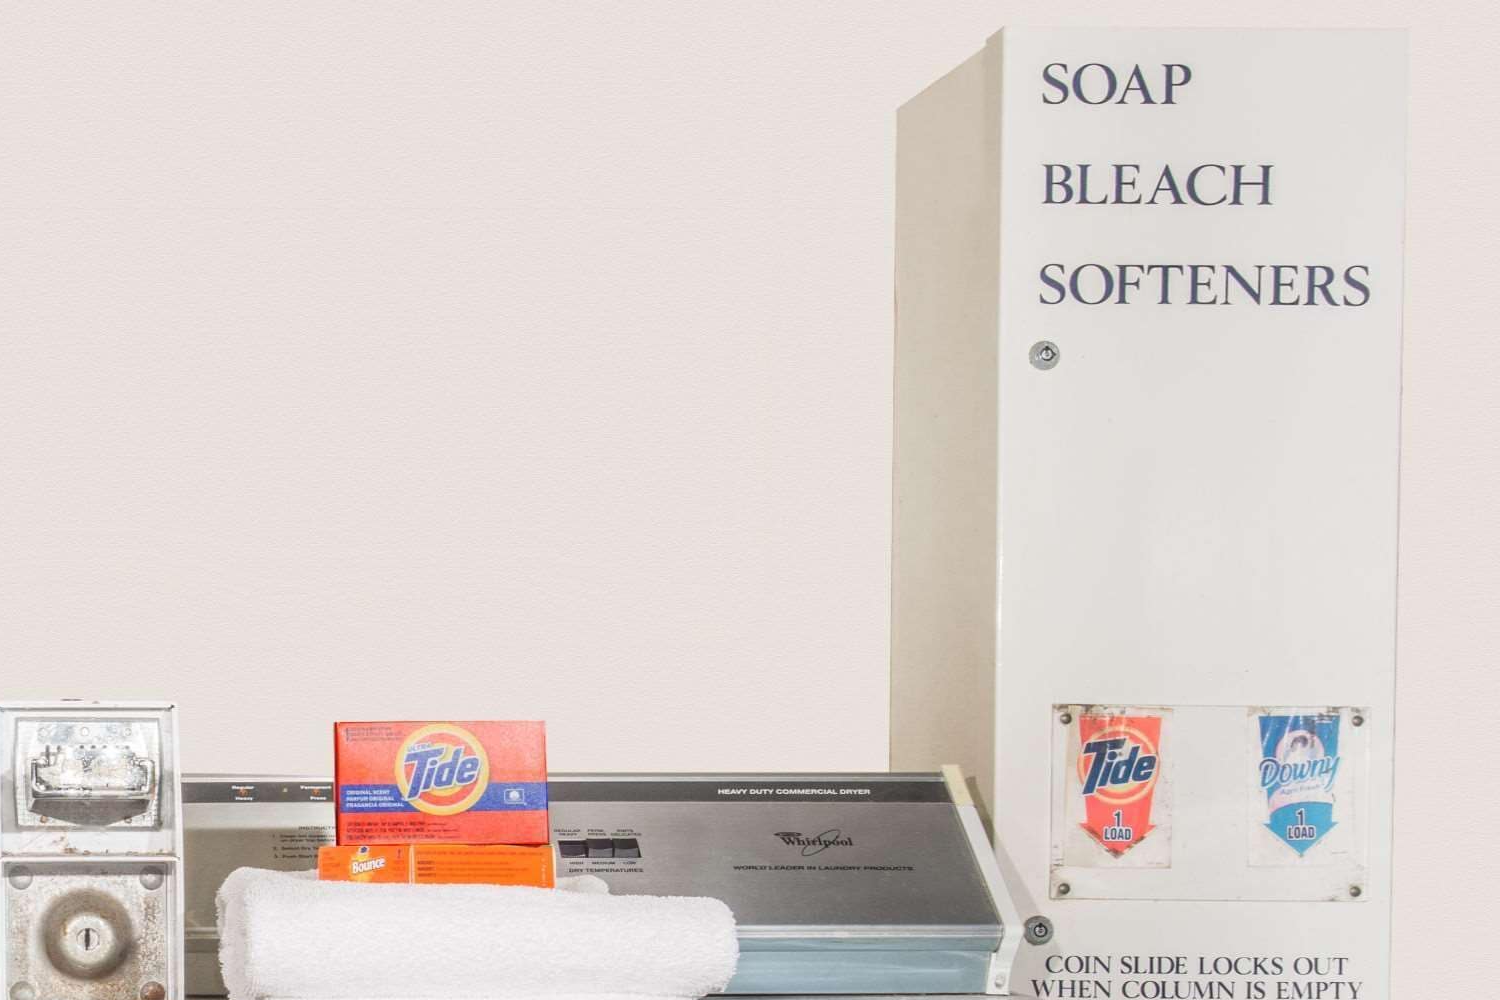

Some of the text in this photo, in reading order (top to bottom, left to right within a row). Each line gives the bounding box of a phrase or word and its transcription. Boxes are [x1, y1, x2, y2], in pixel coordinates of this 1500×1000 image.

[1041, 63, 1192, 105] SOAP
[1041, 164, 1275, 206] BLEACH
[1039, 263, 1371, 307] SOFTENERS
[404, 747, 481, 801] Tide
[1082, 738, 1156, 796] Tide
[1259, 756, 1340, 792] Downy
[1113, 809, 1122, 827] 1
[1296, 808, 1305, 827] 1
[780, 836, 854, 849] Whirlpool
[1104, 826, 1132, 841] LOAD
[1287, 826, 1316, 840] LOAD
[351, 858, 386, 875] Bounce
[1045, 955, 1349, 976] COIN SLIDE LOCKS OUT
[1031, 979, 1363, 1000] WHEN COLUMN IS EMPTY
